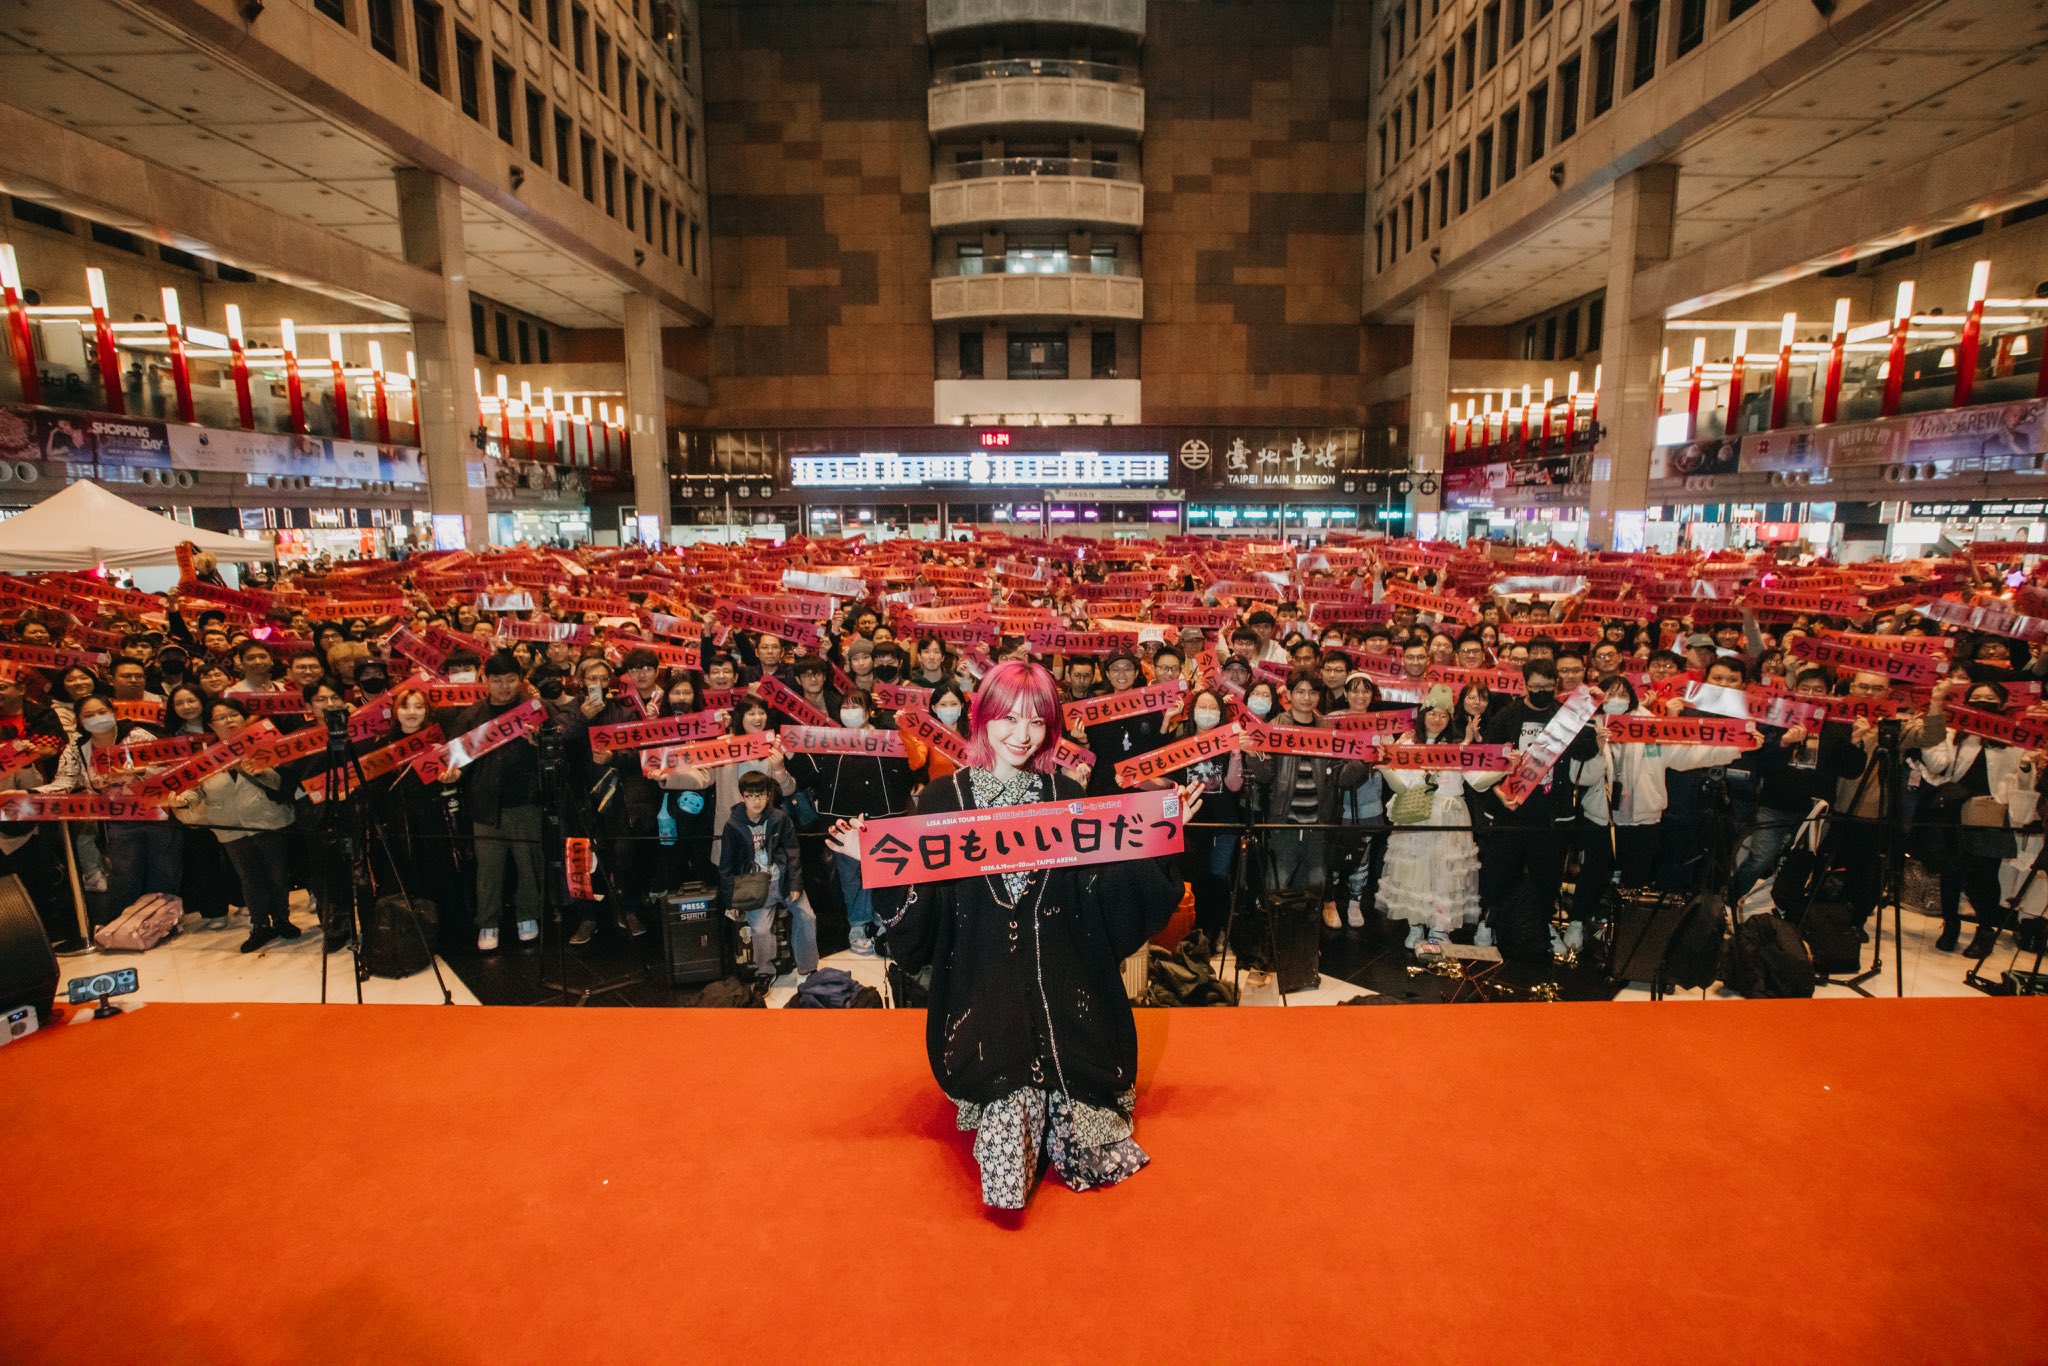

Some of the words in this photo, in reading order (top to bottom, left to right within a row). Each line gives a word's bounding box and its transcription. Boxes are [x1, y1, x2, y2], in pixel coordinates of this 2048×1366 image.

[92, 422, 150, 438] SHOPPING
[981, 433, 1010, 446] 16:24
[1226, 437, 1337, 471] 臺北車站
[1228, 475, 1258, 484] TAIPEI
[1264, 475, 1289, 484] MAIN
[1295, 475, 1336, 484] STATION
[594, 719, 723, 747] 今日もいい日だっ
[1609, 720, 1754, 743] 今日もいい日だっ
[1251, 729, 1378, 755] 今日もいい日だっ
[942, 818, 957, 826] ASIA
[958, 816, 975, 824] TOUR
[869, 813, 1177, 876] 今日もいい日だっ
[1036, 858, 1055, 866] TAIPEI
[681, 902, 706, 911] PRESS
